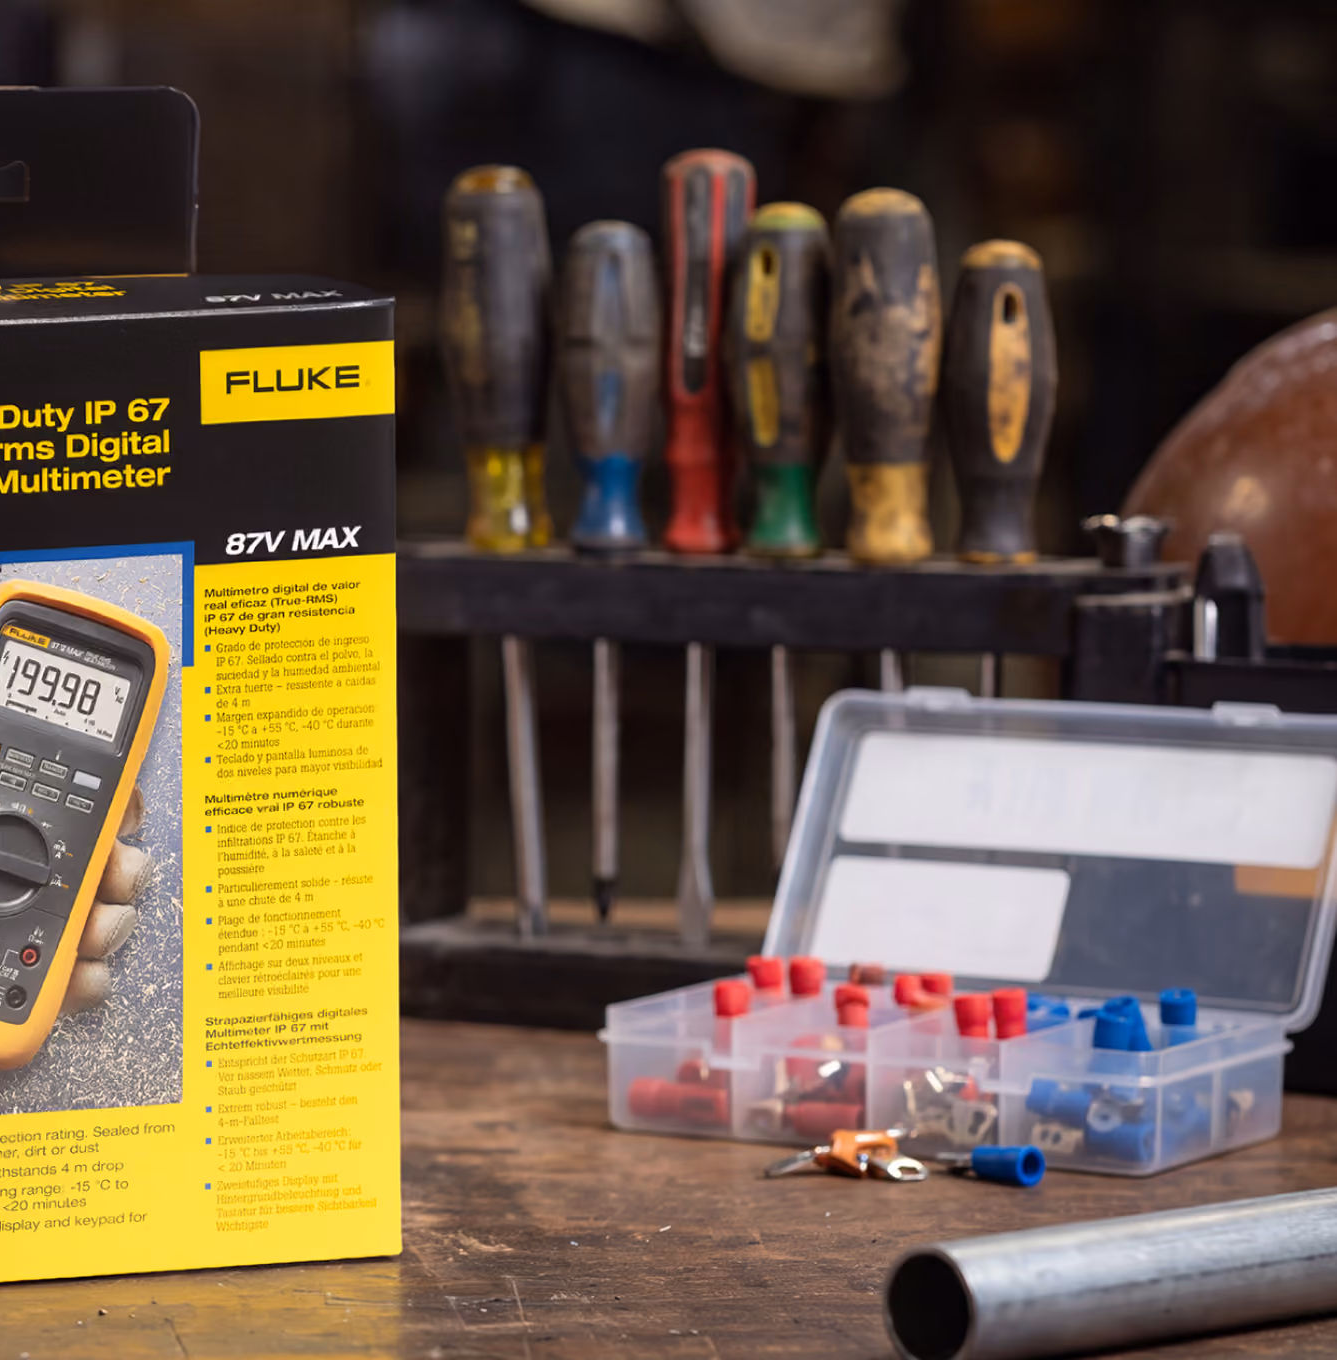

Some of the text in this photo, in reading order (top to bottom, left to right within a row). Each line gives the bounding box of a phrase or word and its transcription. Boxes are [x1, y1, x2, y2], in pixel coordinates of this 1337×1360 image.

[226, 365, 359, 394] FLUKE
[85, 400, 116, 424] IP
[128, 398, 170, 422] 67
[67, 429, 170, 462] Digital
[226, 525, 362, 555] 87V MAX
[273, 583, 308, 595] digital
[312, 583, 327, 591] de
[331, 581, 360, 590] valor
[204, 594, 337, 610] real eficaz (True-RMS)
[220, 613, 234, 621] 67
[239, 612, 253, 621] de
[258, 611, 285, 622] gran
[289, 606, 355, 617] resistencia
[205, 623, 280, 636] (Heavy Duty)
[205, 798, 364, 816] efficace vrai IP 67 robuste
[317, 1008, 367, 1019] digitales
[206, 1022, 328, 1038] Multimeter IP 67 mit
[46, 1129, 87, 1143] rating.
[93, 1124, 139, 1138] Sealed
[144, 1122, 175, 1134] from
[25, 1146, 46, 1157] dirt
[51, 1145, 66, 1155] or
[71, 1143, 99, 1154] dust
[61, 1163, 69, 1174] 4
[74, 1163, 87, 1173] m
[92, 1161, 124, 1173] drop
[116, 1180, 128, 1190] to
[3, 1200, 28, 1212] <20
[33, 1197, 86, 1209] minutes
[45, 1217, 70, 1228] and
[75, 1213, 125, 1228] keypad
[129, 1213, 147, 1223] for
